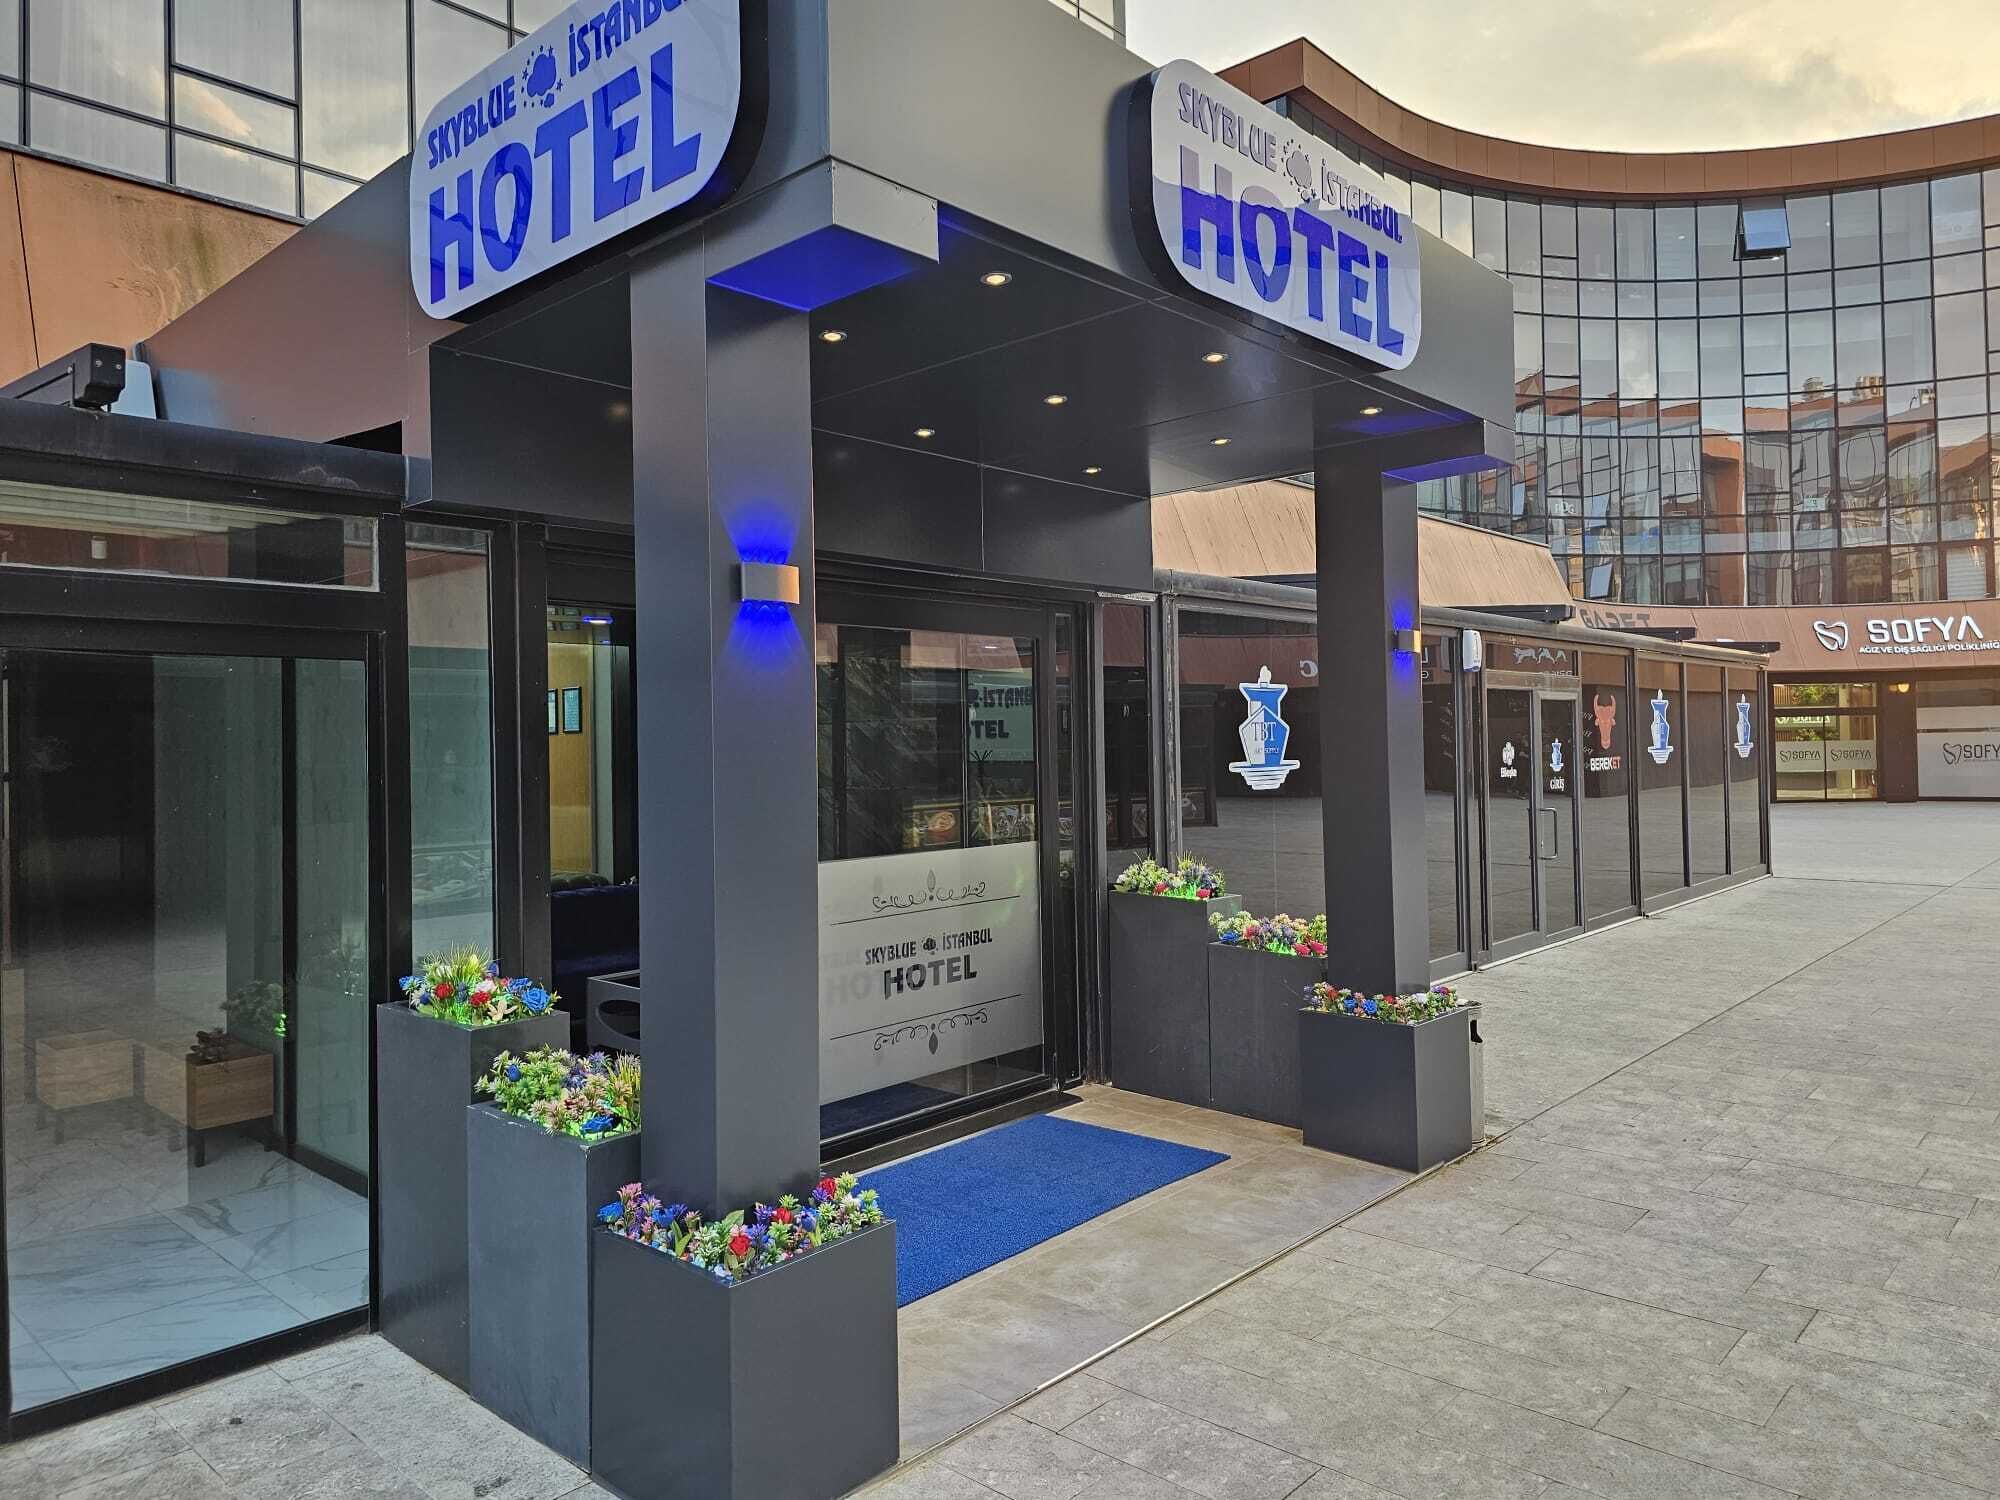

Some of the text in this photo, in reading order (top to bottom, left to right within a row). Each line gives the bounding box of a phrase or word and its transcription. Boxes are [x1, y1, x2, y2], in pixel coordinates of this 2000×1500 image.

[428, 0, 688, 169] SKYBLUE İSTANB
[429, 42, 701, 304] HOTEL
[1178, 82, 1403, 243] SKYBLUE İSTANBUL
[1180, 144, 1404, 356] HOTEL
[1867, 615, 1984, 643] SOFYA
[1251, 721, 1277, 741] TBT
[1590, 756, 1621, 772] BEREKET
[1792, 750, 1821, 760] SOFYA
[865, 927, 993, 965] SKYBLUE İSTANBUL
[884, 954, 978, 1001] HOTEL
